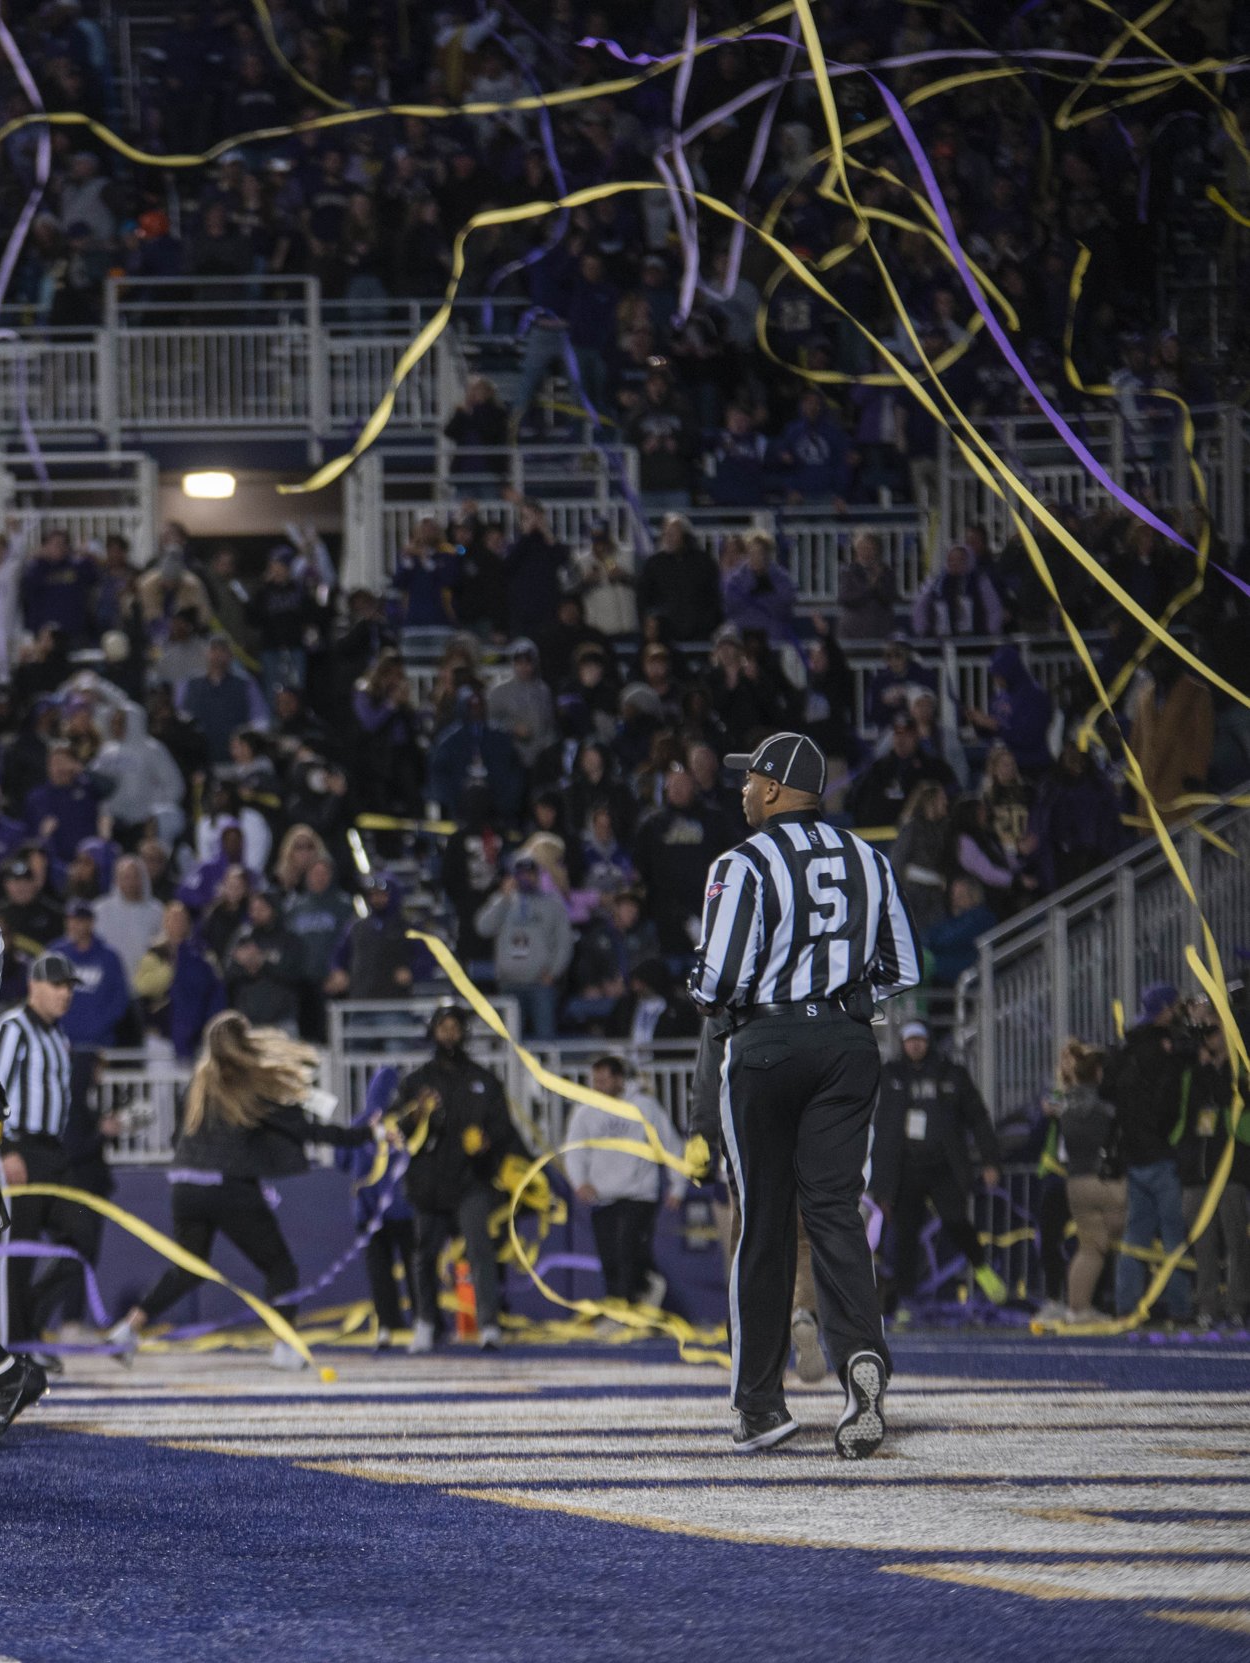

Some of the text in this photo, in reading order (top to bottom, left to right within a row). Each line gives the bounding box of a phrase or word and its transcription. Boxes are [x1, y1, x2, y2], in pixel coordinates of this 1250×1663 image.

[764, 761, 774, 771] S
[808, 831, 818, 842] S
[805, 856, 848, 937] S
[805, 1004, 818, 1017] S
